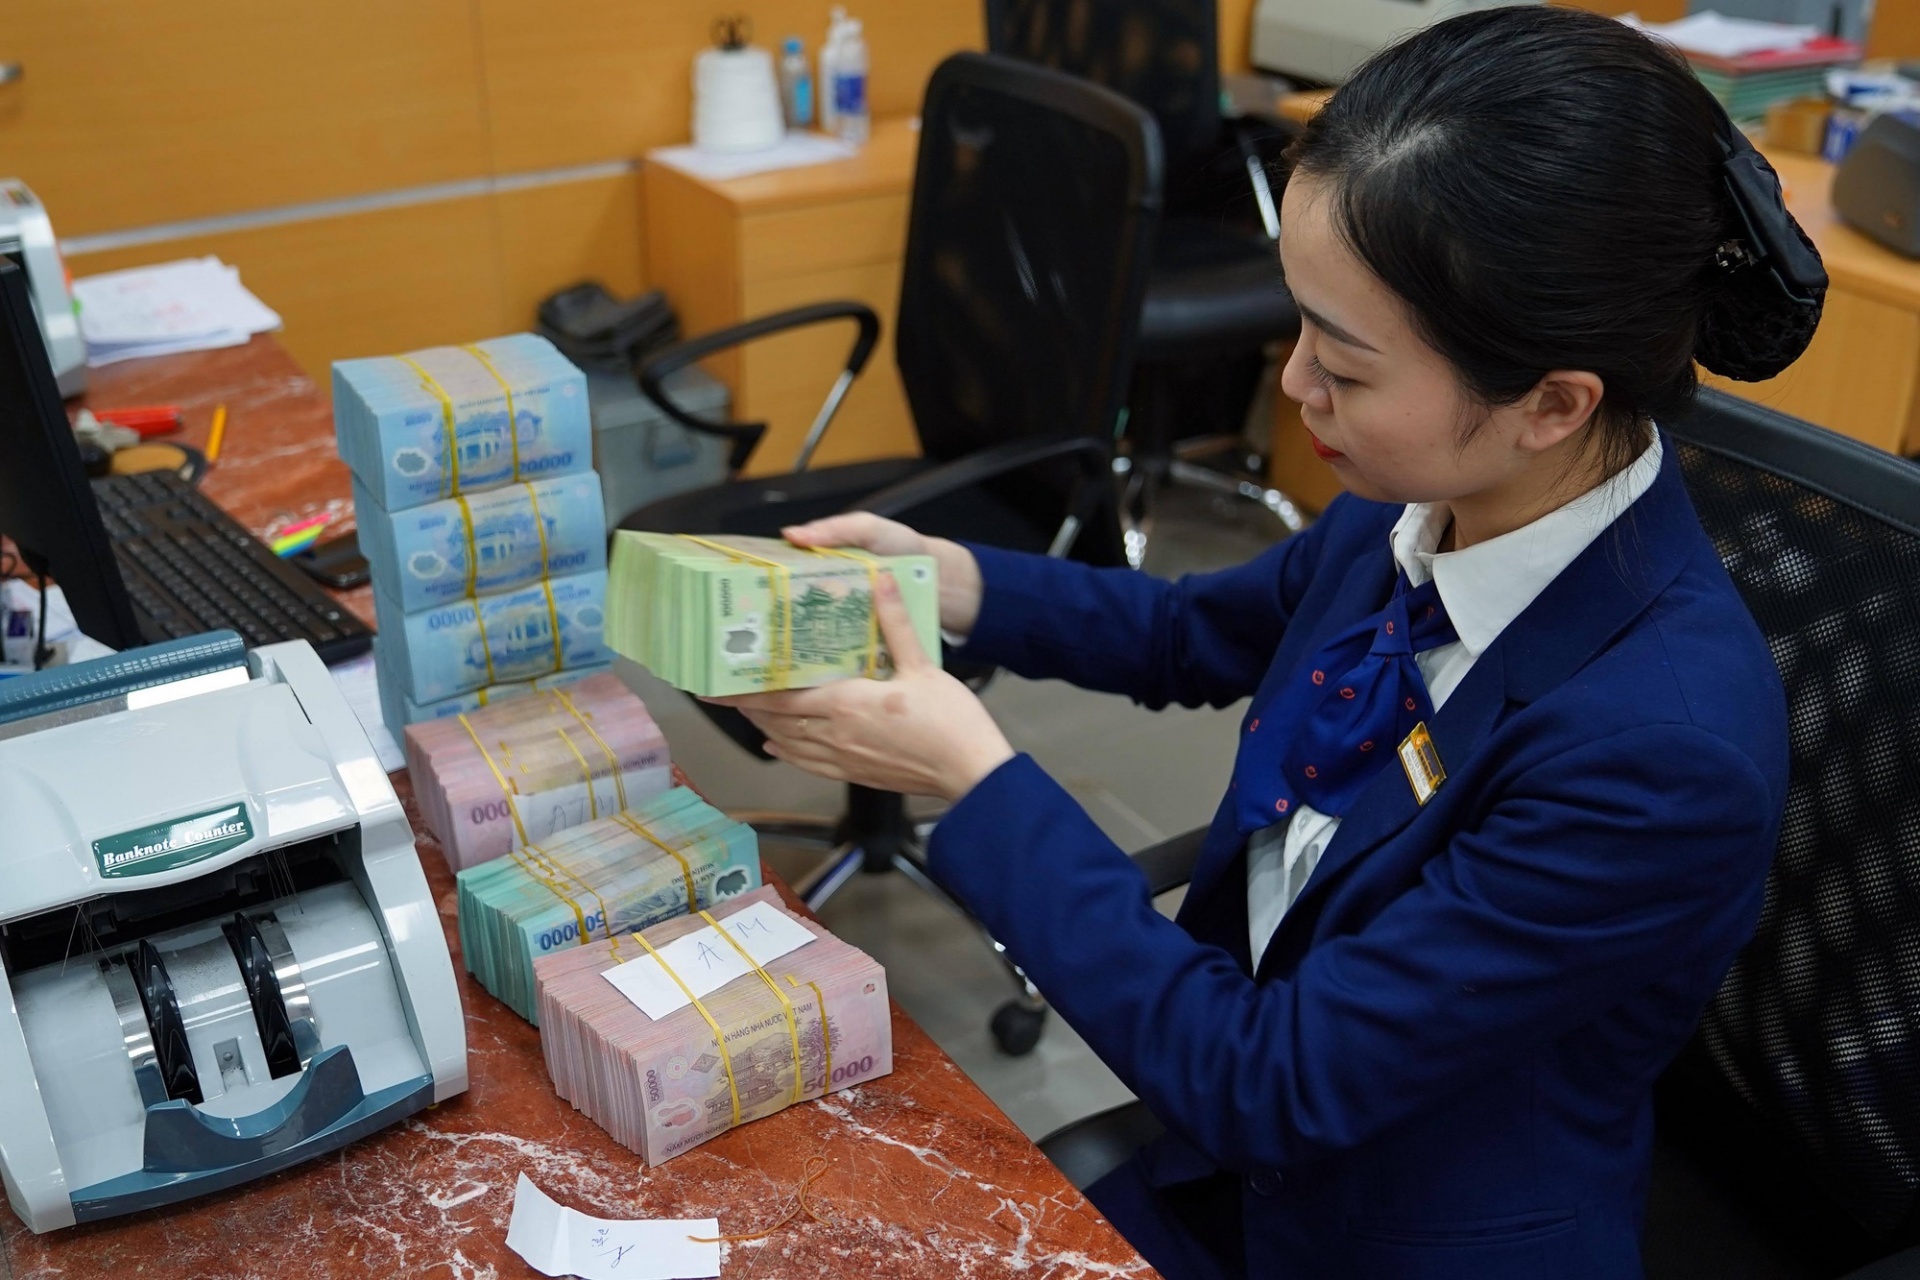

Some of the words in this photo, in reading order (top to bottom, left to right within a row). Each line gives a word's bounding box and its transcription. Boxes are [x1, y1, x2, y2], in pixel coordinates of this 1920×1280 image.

[103, 837, 177, 867] Banknote
[184, 821, 245, 844] Counter
[799, 1002, 812, 1014] NAM
